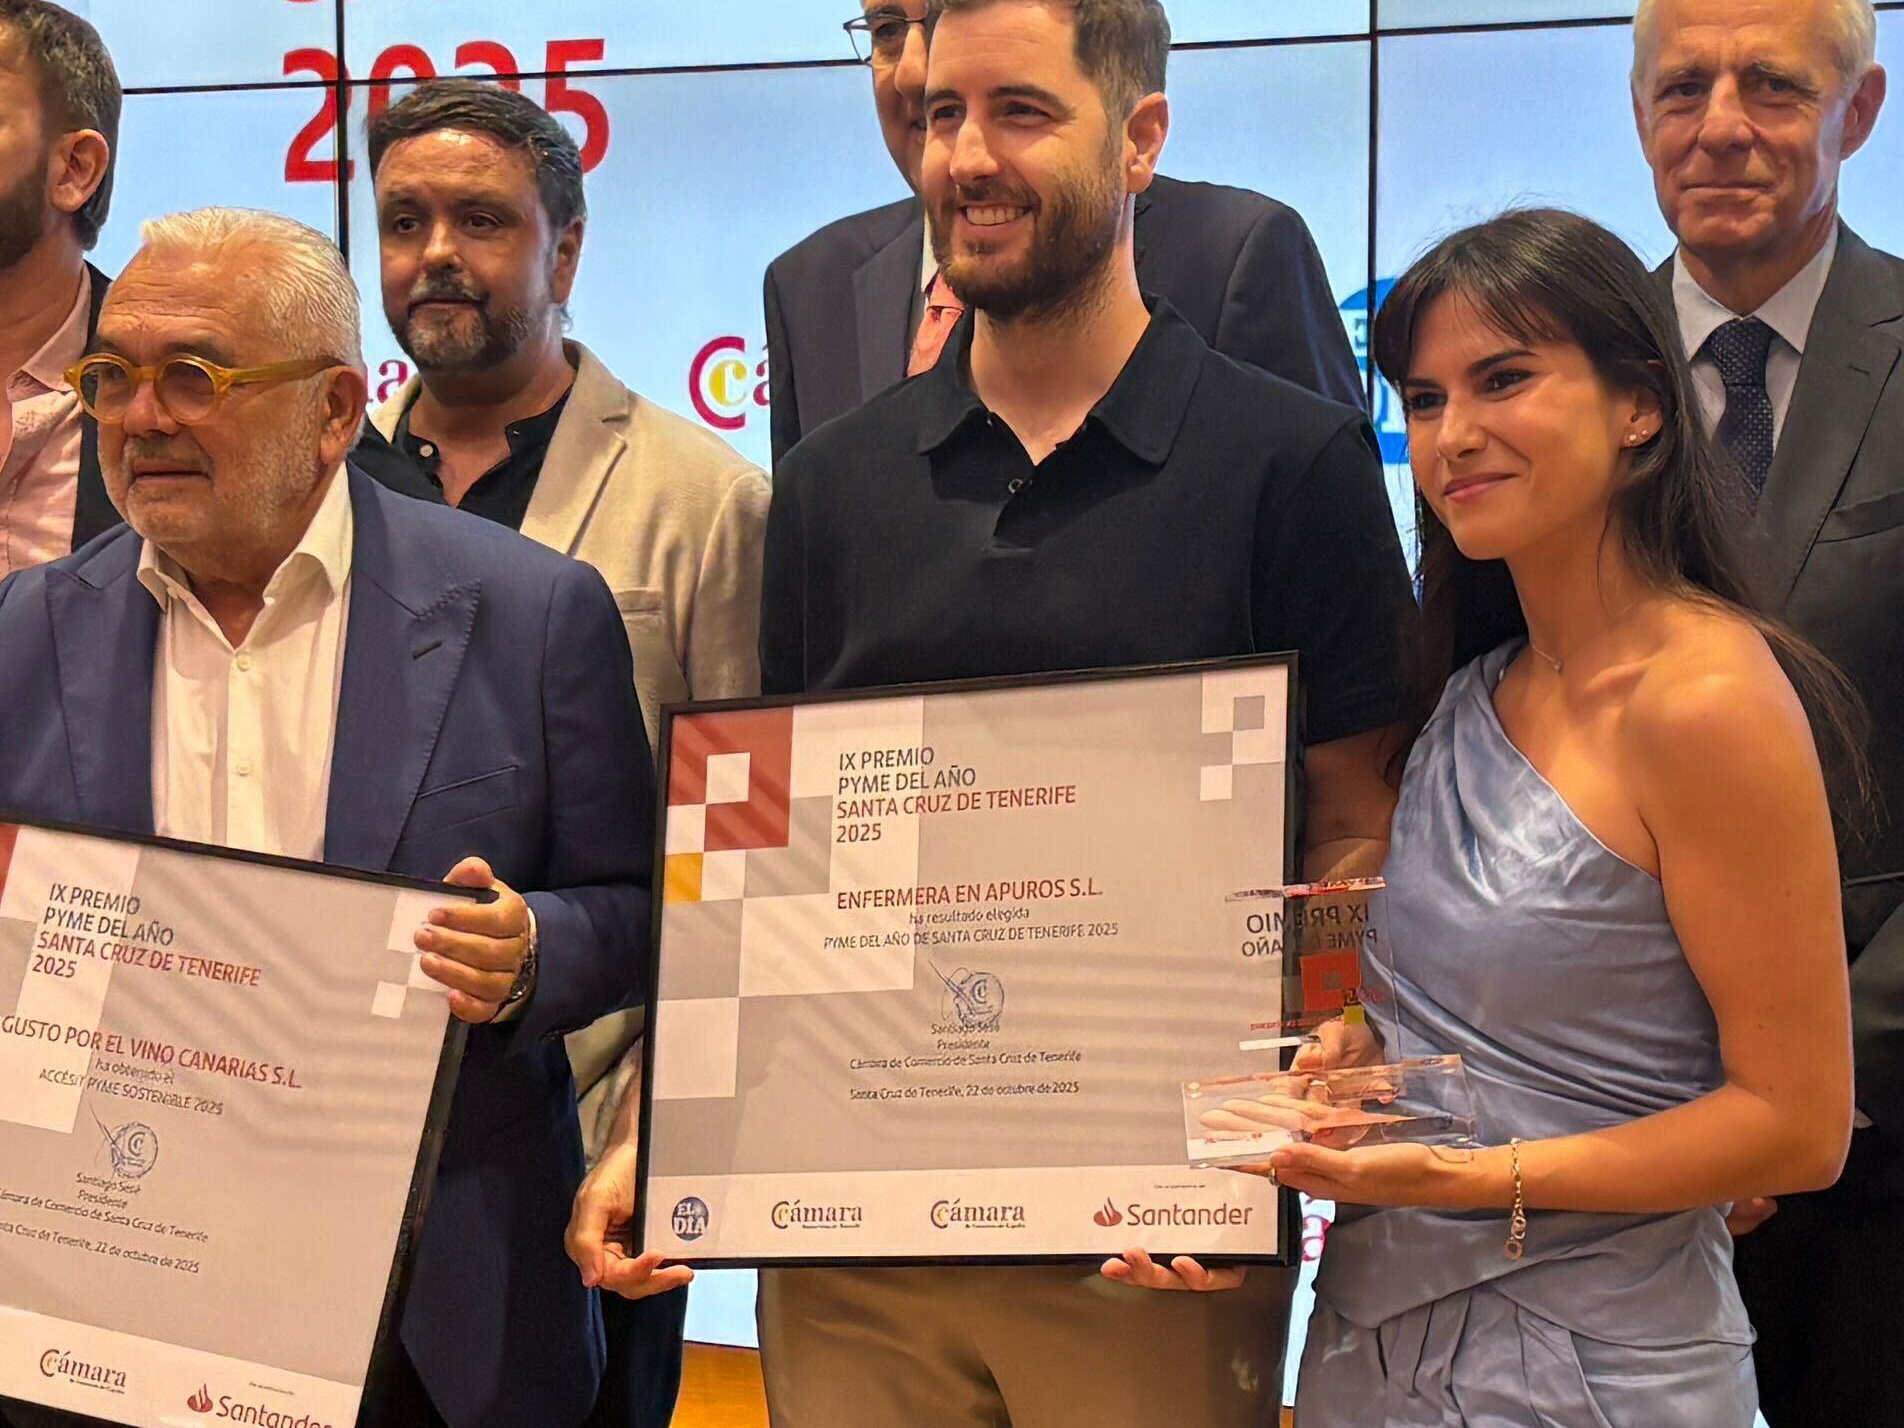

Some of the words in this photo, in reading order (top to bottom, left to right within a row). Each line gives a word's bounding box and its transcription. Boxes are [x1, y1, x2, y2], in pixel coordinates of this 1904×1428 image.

[282, 38, 610, 183] 25
[839, 752, 856, 771] IX
[861, 746, 934, 769] PREMIO
[838, 774, 890, 795] PYME
[896, 772, 930, 790] DEL
[934, 765, 976, 789] AÑO
[836, 798, 898, 819] SANTA
[903, 794, 952, 814] CRUZ
[957, 792, 982, 812] DE
[986, 785, 1077, 808] TENERIFE
[836, 822, 882, 843] 2025
[50, 883, 68, 902] IX
[69, 887, 140, 915] PREMIO
[837, 885, 951, 910] ENFERMERA
[956, 883, 981, 903] EN
[986, 878, 1066, 901] APUROS
[43, 906, 95, 931] PYME
[97, 917, 128, 938] DEL
[132, 919, 174, 947] AÑO
[860, 933, 881, 948] DEL
[931, 930, 971, 944] SANTA
[973, 928, 1006, 942] CRUZ
[1008, 928, 1024, 940] DE
[1087, 922, 1119, 936] 2025
[32, 954, 77, 978] 2025
[37, 931, 95, 957] SANTA
[100, 942, 149, 966] CRUZ
[149, 950, 174, 971] DE
[178, 955, 262, 987] TENERIFE
[2, 1015, 61, 1041] GUSTO
[65, 1026, 102, 1050] POR
[105, 1035, 125, 1054] EL
[131, 1038, 175, 1066] VINO
[179, 1049, 269, 1082] CANARIAS
[1127, 1203, 1253, 1225] Santander
